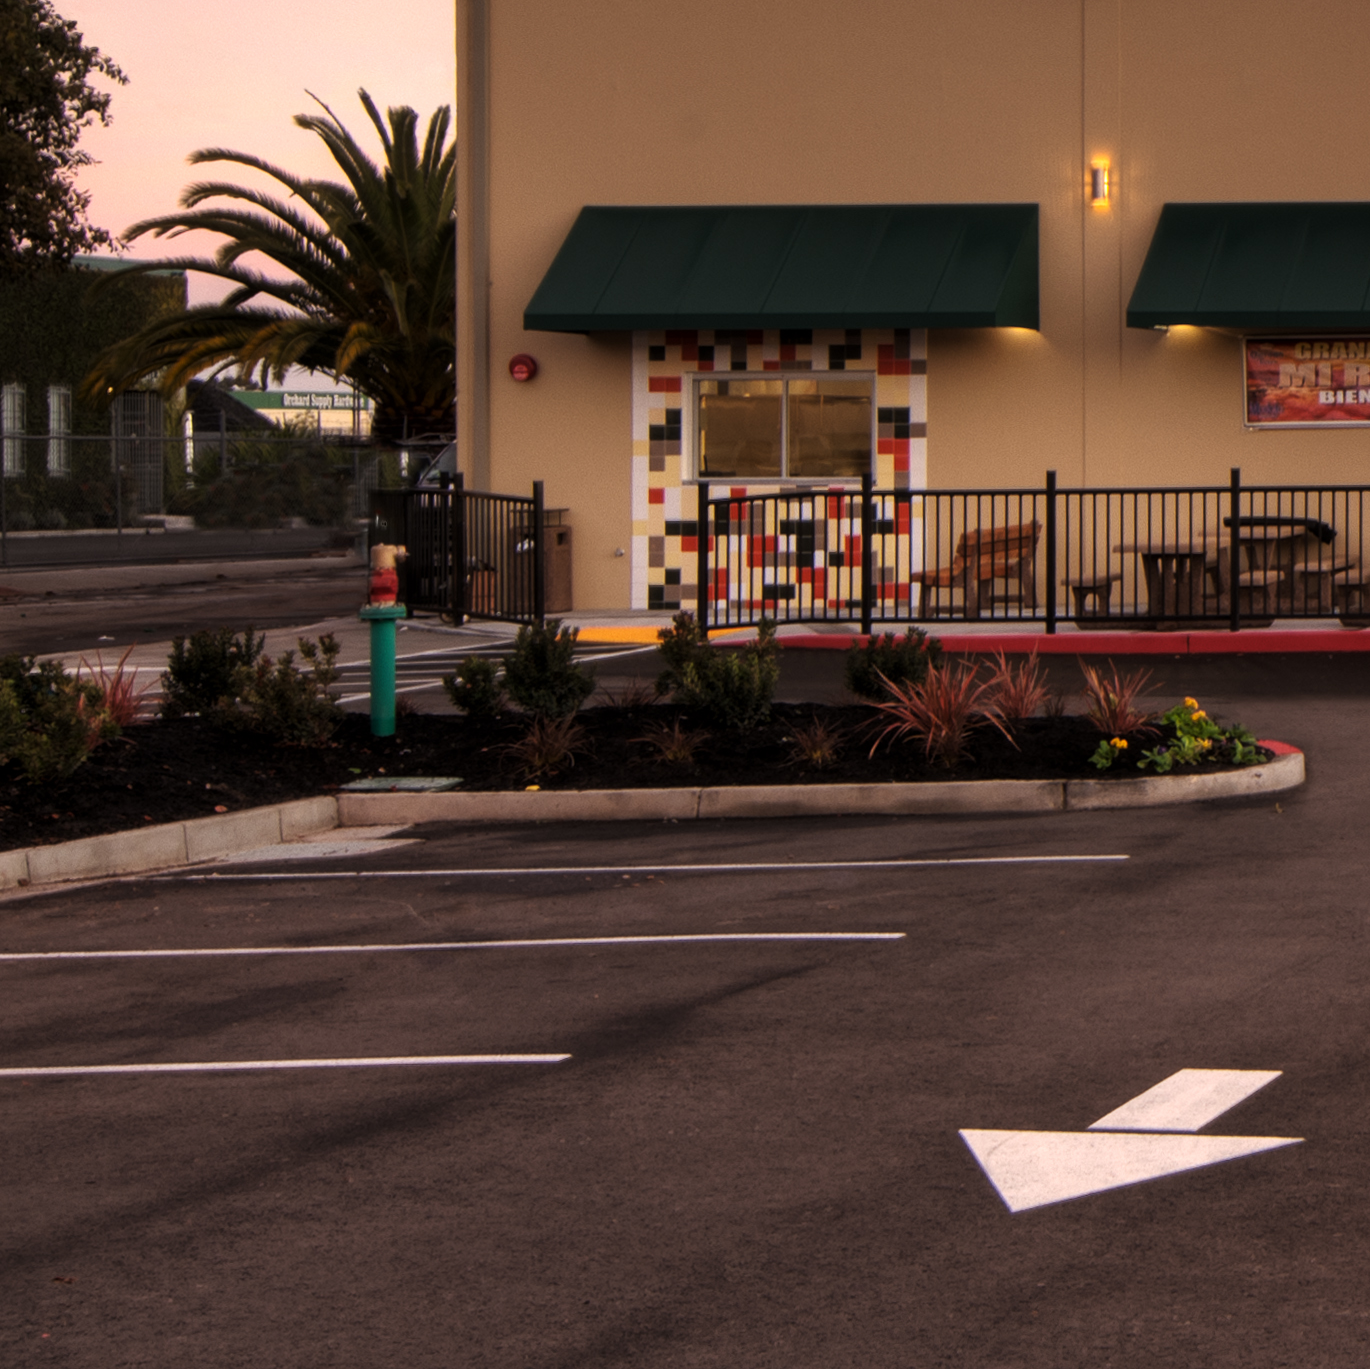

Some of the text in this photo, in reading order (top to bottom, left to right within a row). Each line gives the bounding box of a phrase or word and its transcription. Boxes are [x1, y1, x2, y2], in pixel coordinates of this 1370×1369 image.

[1278, 362, 1333, 388] MI
[283, 392, 310, 408] Orchard
[310, 393, 333, 410] Supply
